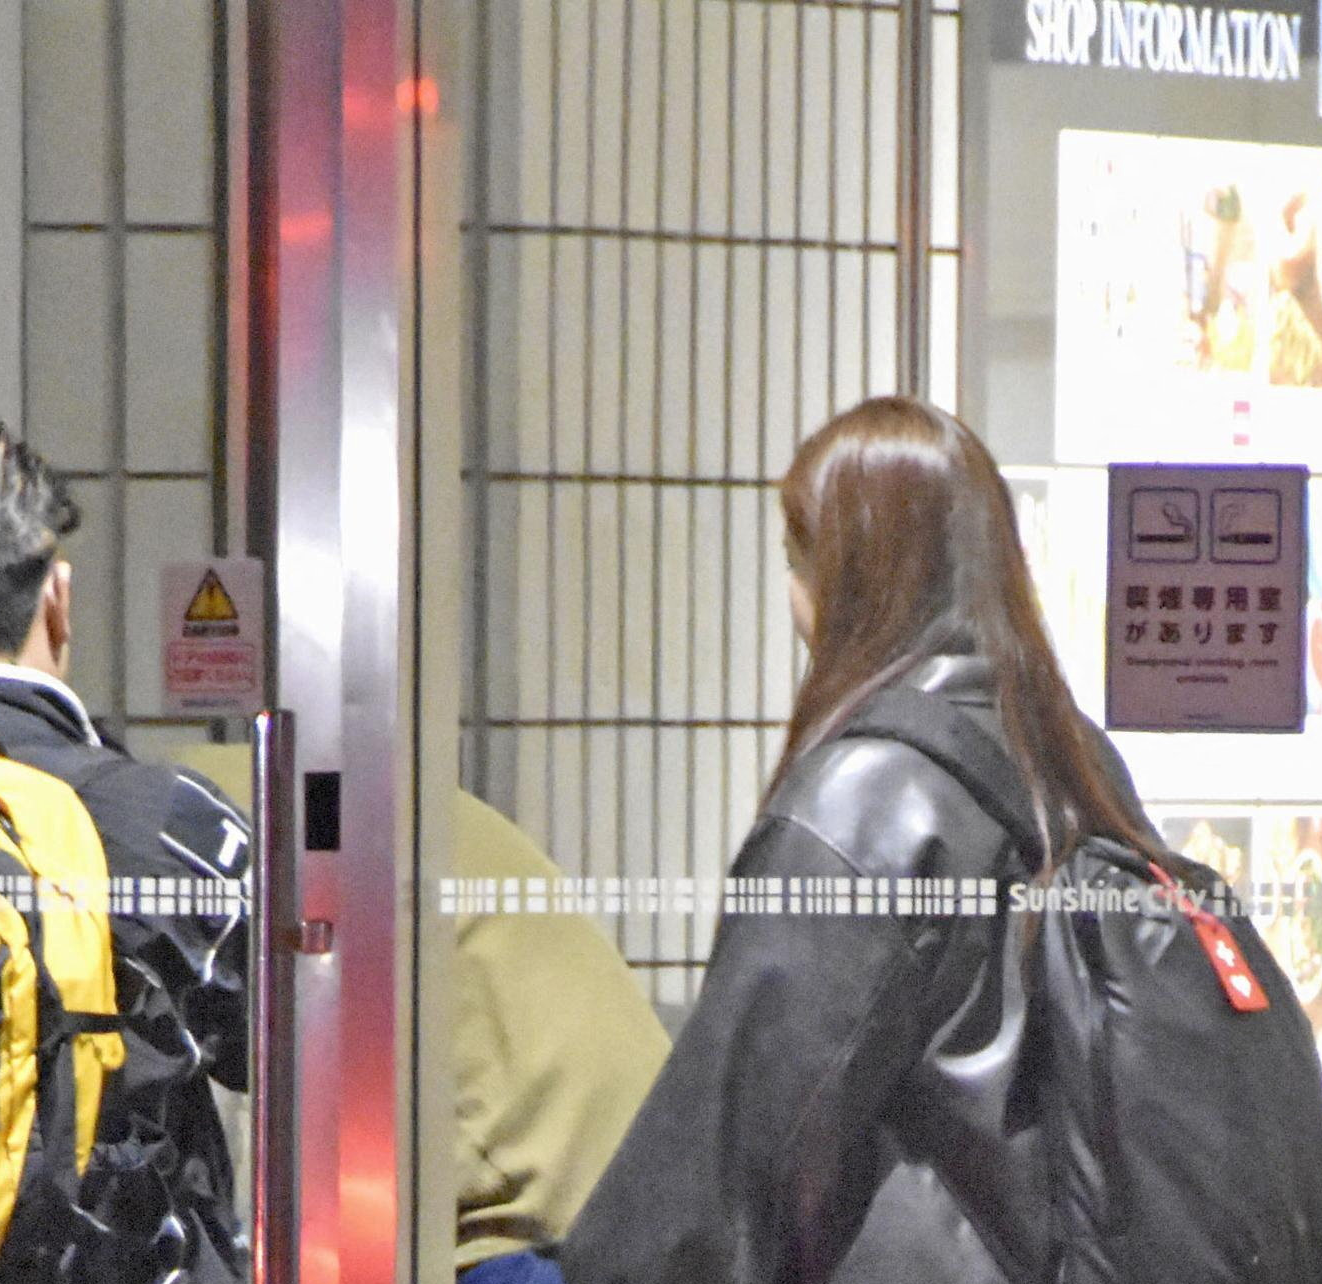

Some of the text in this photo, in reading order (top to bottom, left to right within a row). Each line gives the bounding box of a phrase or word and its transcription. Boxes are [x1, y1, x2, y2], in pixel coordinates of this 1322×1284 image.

[1026, 0, 1301, 81] SHOP INFORMATION
[1125, 621, 1280, 646] があります
[1009, 879, 1207, 917] Sunshine City
